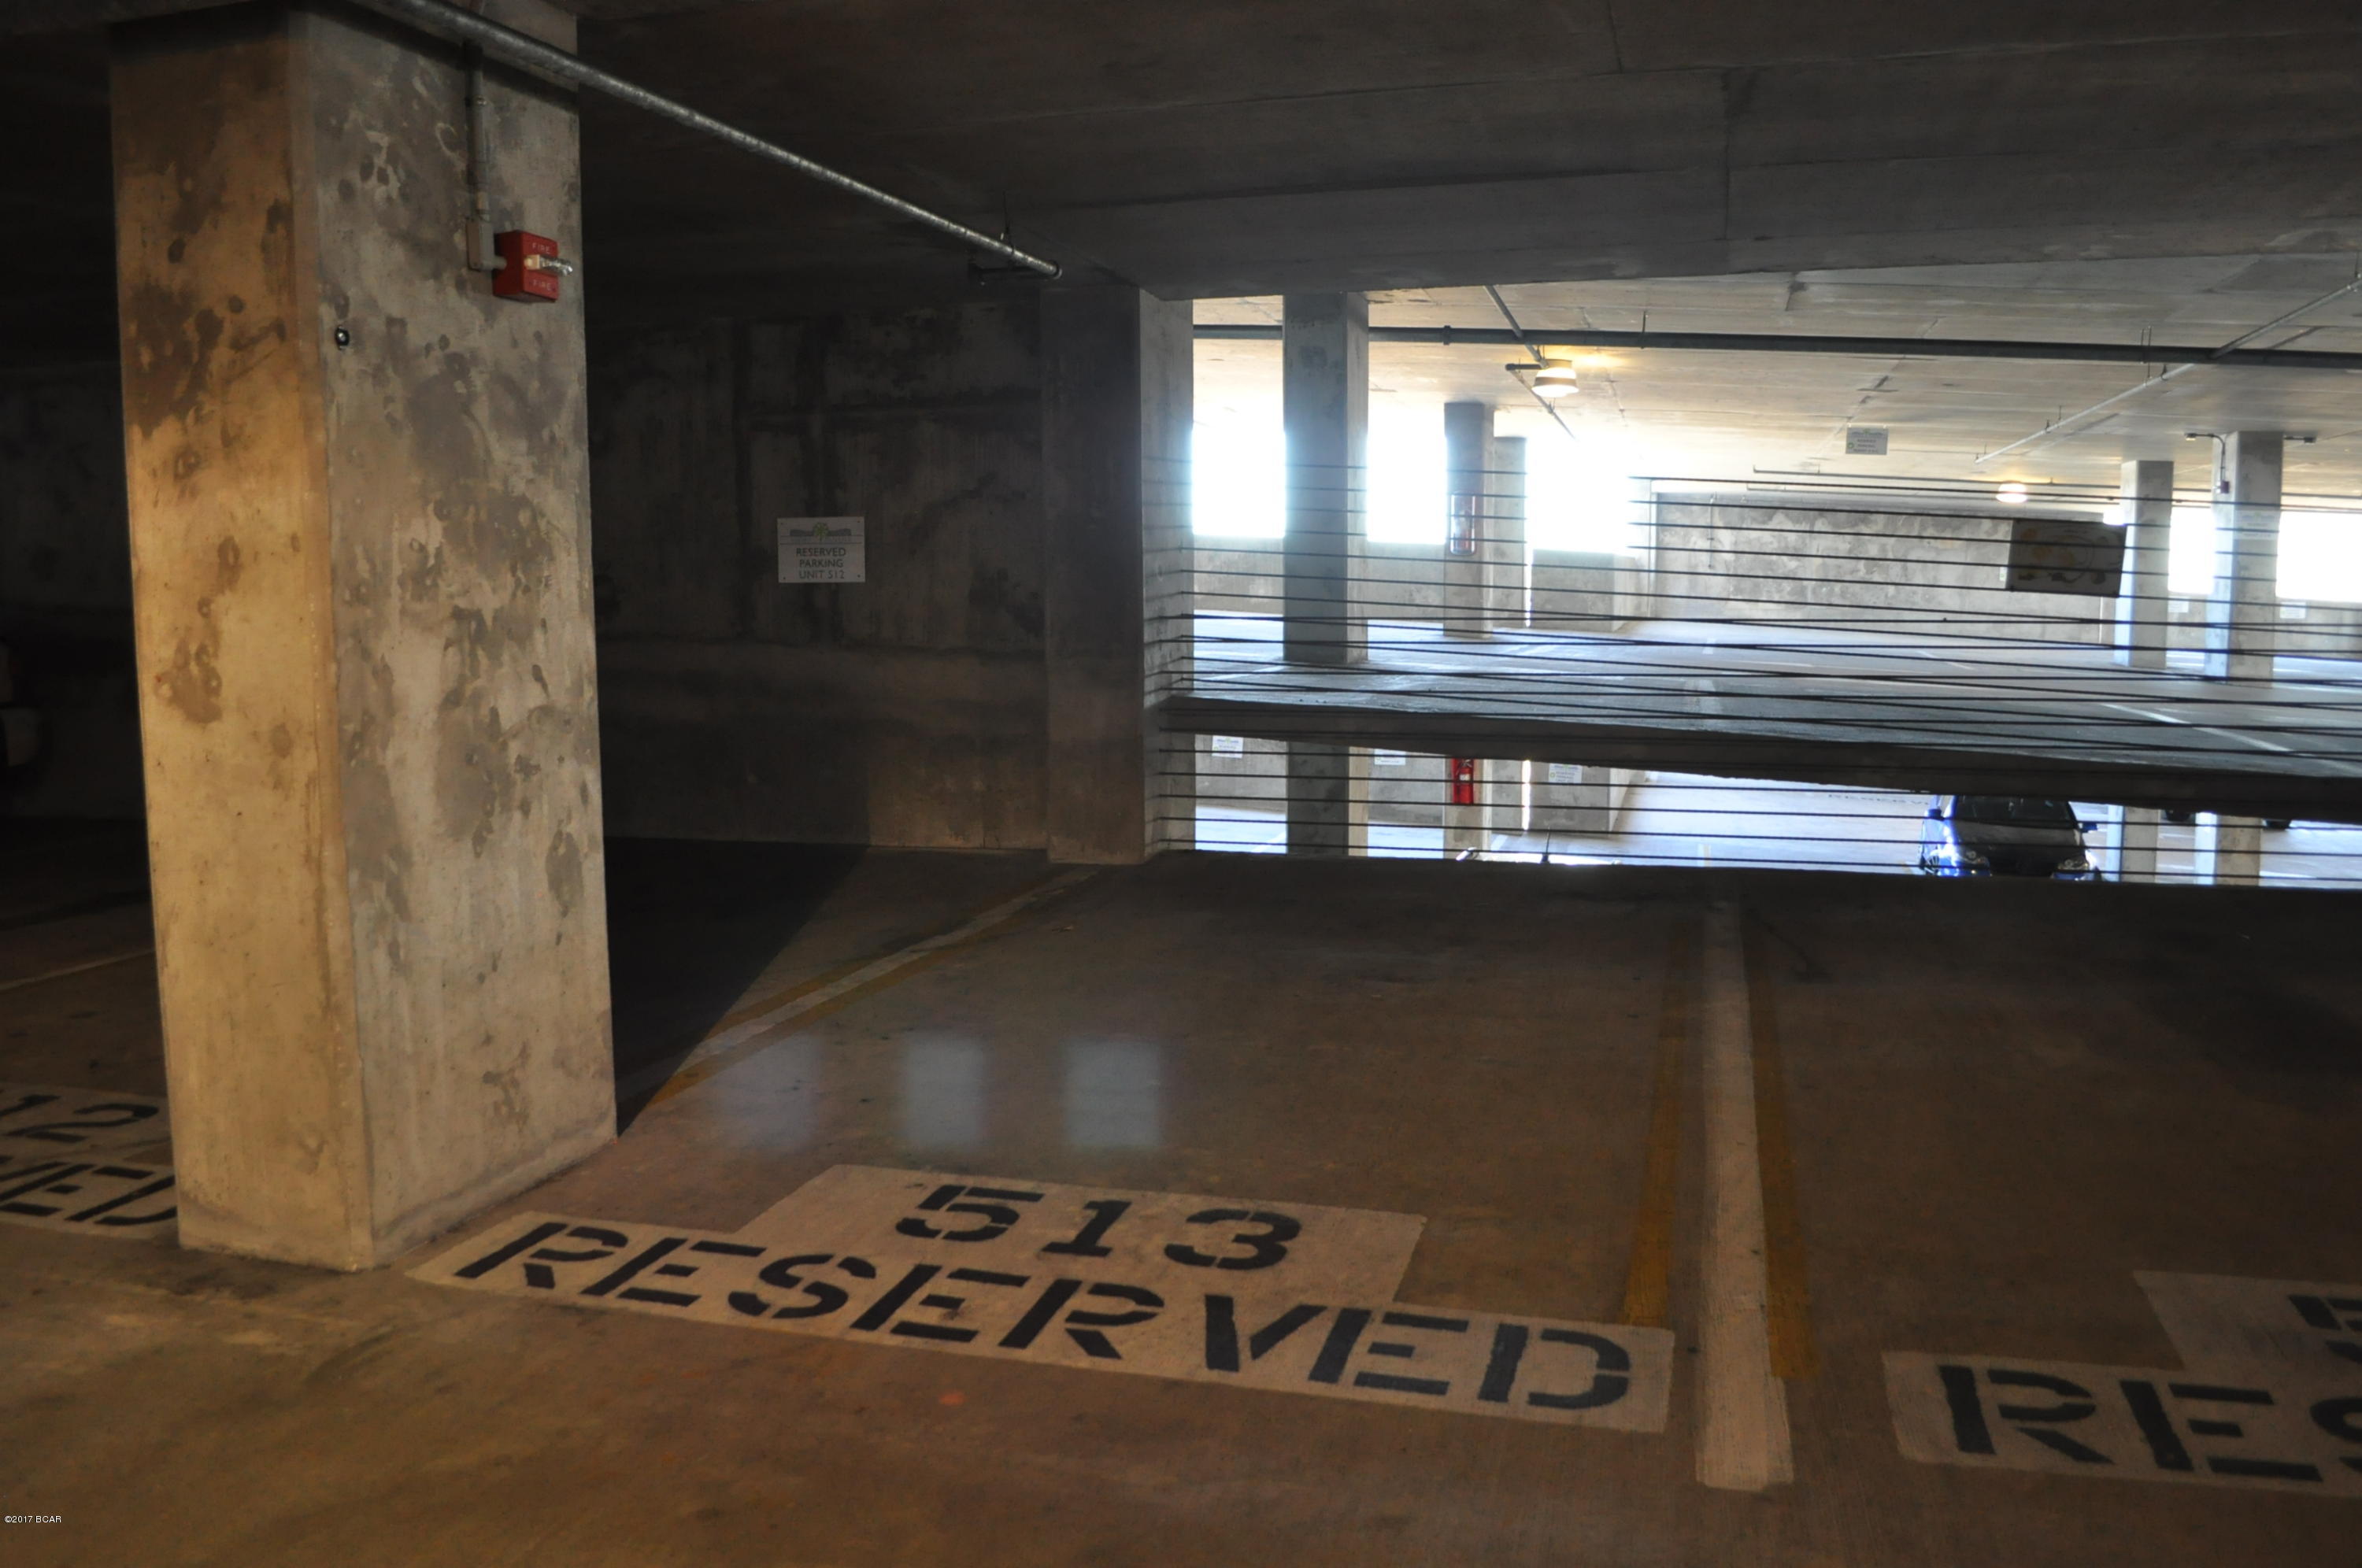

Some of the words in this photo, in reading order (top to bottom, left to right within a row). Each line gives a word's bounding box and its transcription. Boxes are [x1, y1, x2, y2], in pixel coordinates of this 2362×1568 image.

[531, 242, 550, 254] FIRE
[796, 547, 846, 557] RESERVED
[799, 559, 844, 568] PARKING
[798, 570, 825, 579] UNIT
[895, 1185, 1301, 1270] 513
[454, 1222, 1631, 1410] RESERVED
